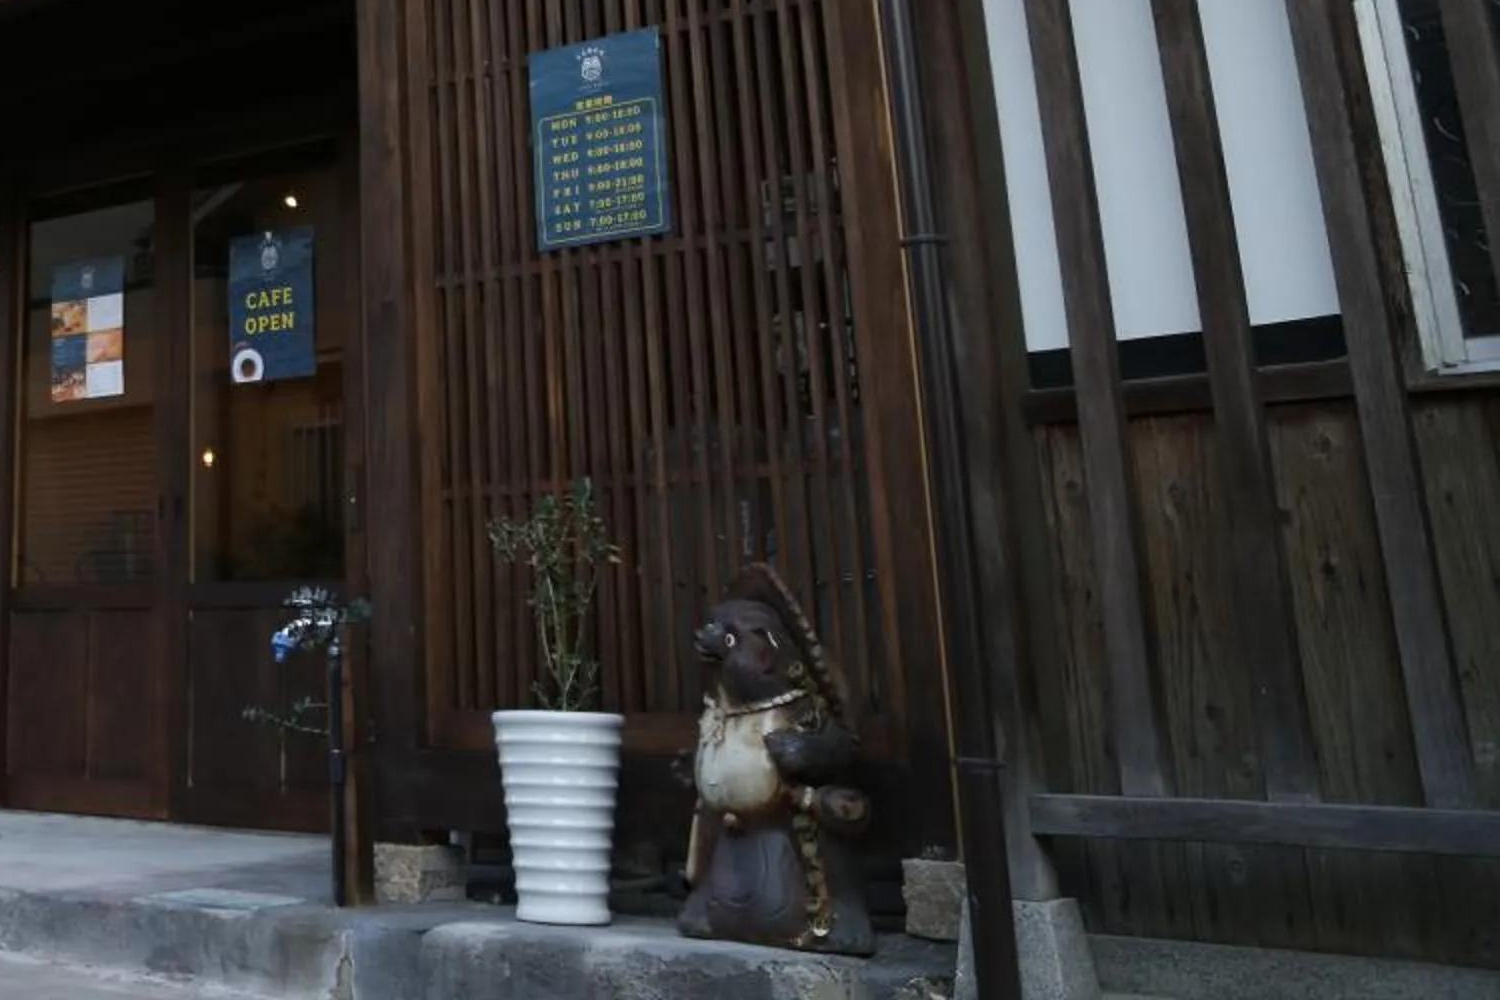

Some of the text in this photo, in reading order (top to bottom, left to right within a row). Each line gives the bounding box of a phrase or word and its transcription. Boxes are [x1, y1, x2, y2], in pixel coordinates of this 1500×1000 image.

[551, 119, 578, 131] MON
[551, 134, 578, 149] TUE
[553, 150, 579, 165] WED
[553, 168, 580, 182] THU
[554, 201, 581, 215] SAT
[555, 218, 582, 233] SUN
[245, 287, 293, 309] CAFE
[244, 312, 295, 334] OPEN
